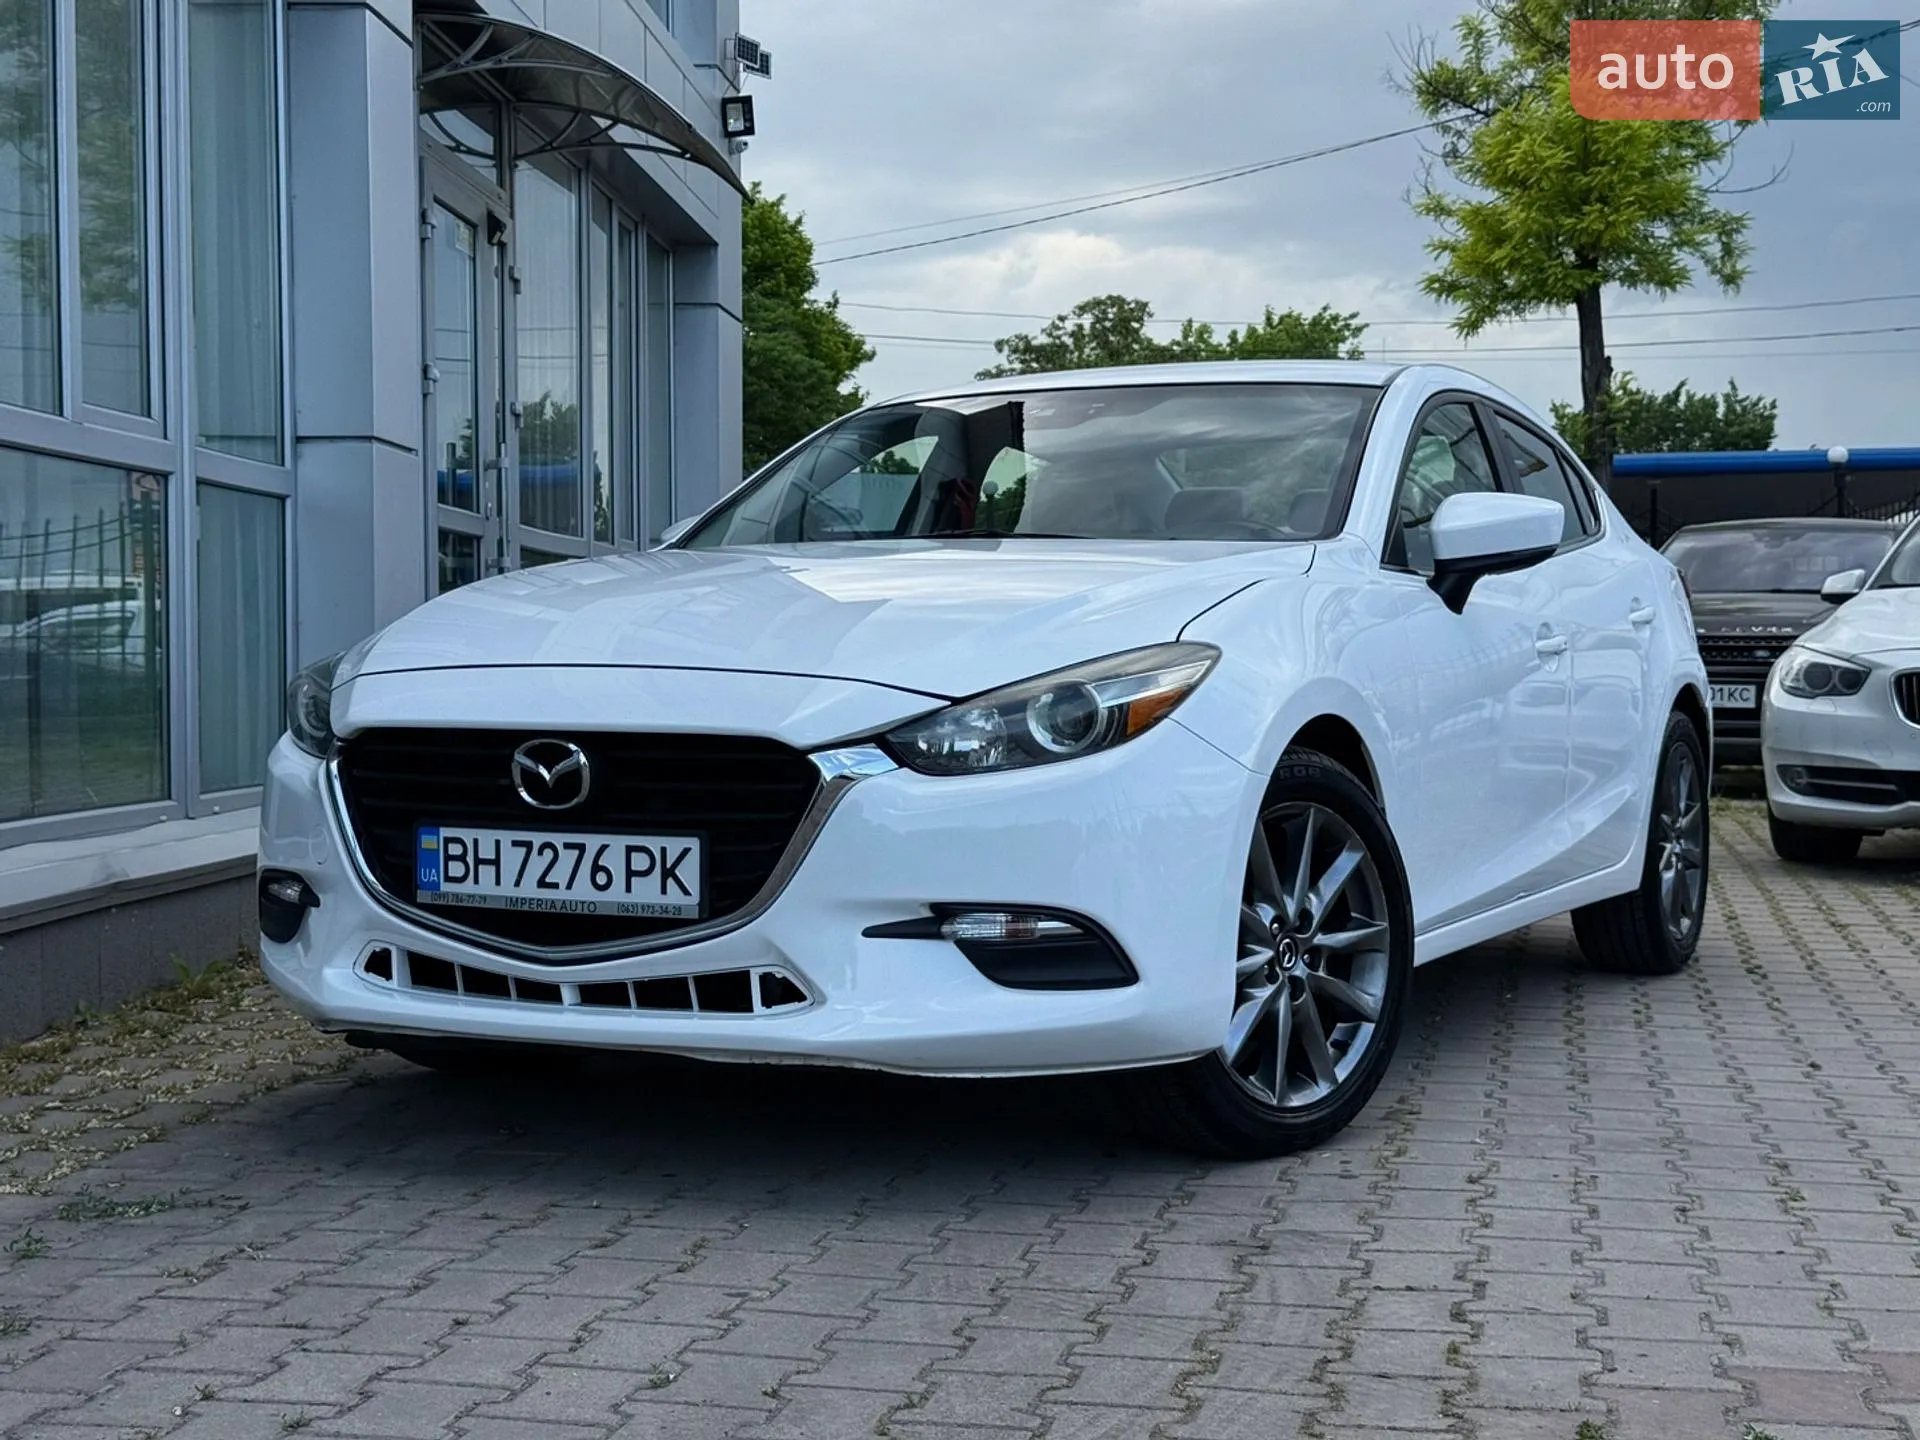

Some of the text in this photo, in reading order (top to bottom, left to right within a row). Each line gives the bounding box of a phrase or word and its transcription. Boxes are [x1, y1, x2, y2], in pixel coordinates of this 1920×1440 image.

[421, 867, 439, 883] UA
[443, 836, 692, 896] BH 7276 PK
